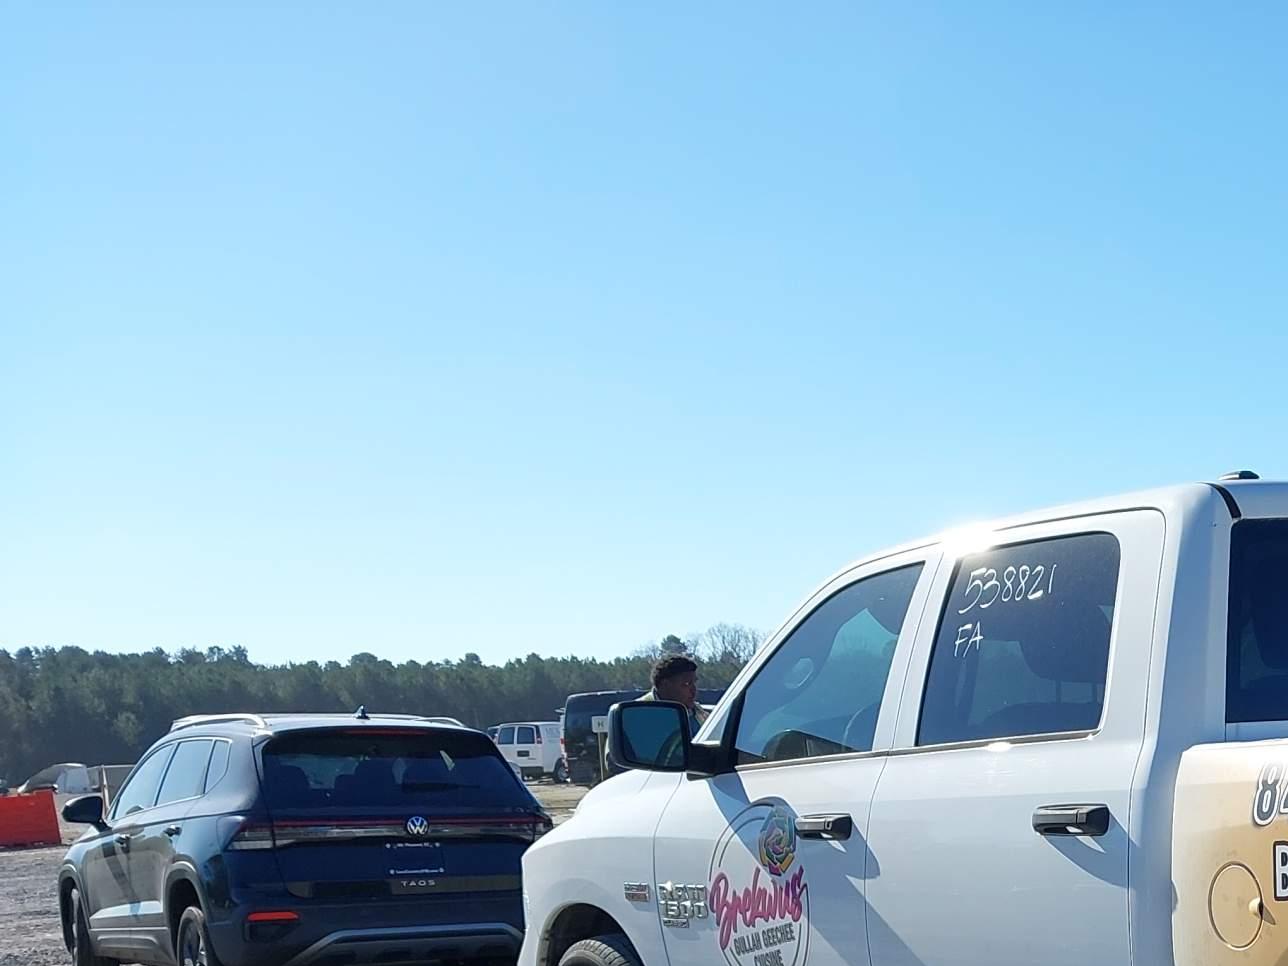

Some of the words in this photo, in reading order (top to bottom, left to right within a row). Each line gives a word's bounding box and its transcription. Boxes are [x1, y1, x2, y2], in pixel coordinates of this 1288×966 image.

[957, 563, 1057, 615] 538821
[953, 621, 984, 657] FA
[709, 864, 804, 951] Brekwus
[733, 931, 762, 957] GULLAH
[761, 921, 796, 949] GEECHEE
